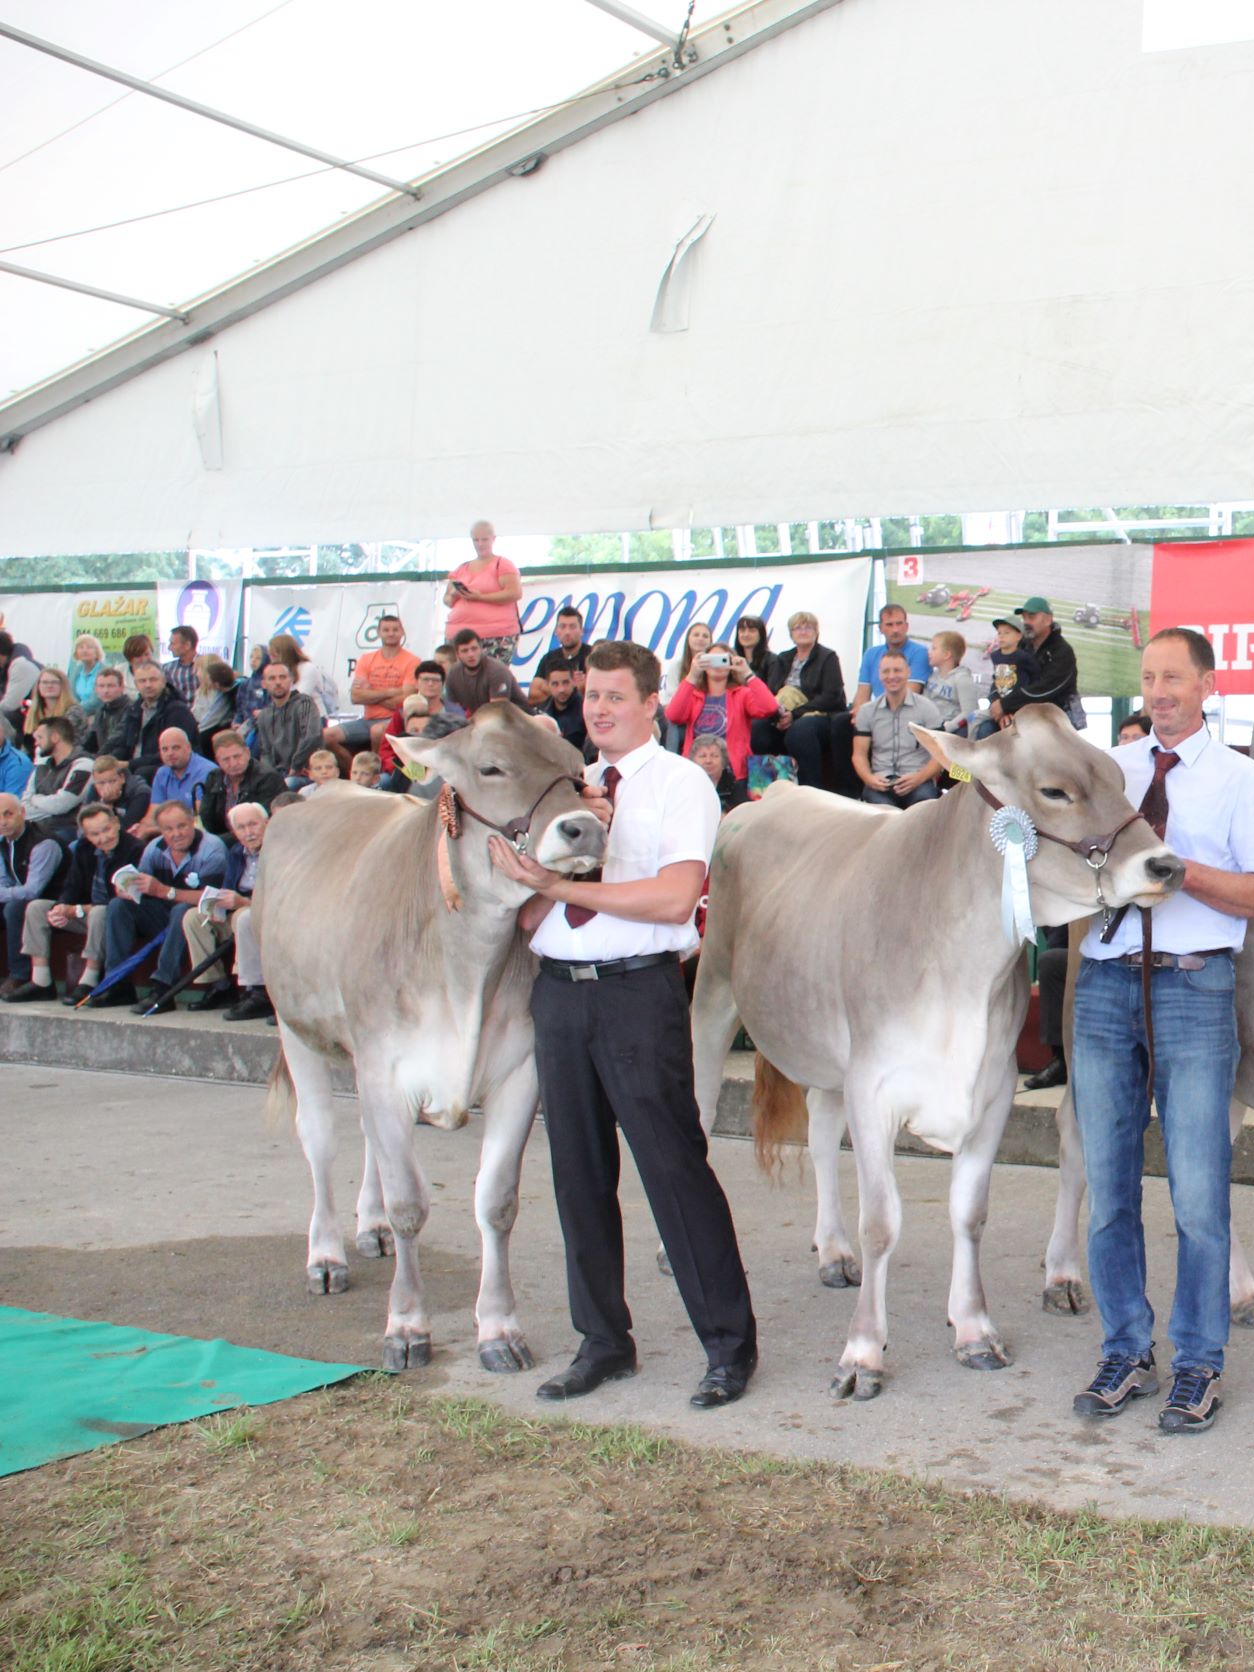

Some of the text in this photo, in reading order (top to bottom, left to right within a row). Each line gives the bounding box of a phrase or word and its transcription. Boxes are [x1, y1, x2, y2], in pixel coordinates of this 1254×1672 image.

[903, 557, 919, 579] 3
[78, 597, 149, 618] GLAŽAR
[111, 627, 127, 640] 686
